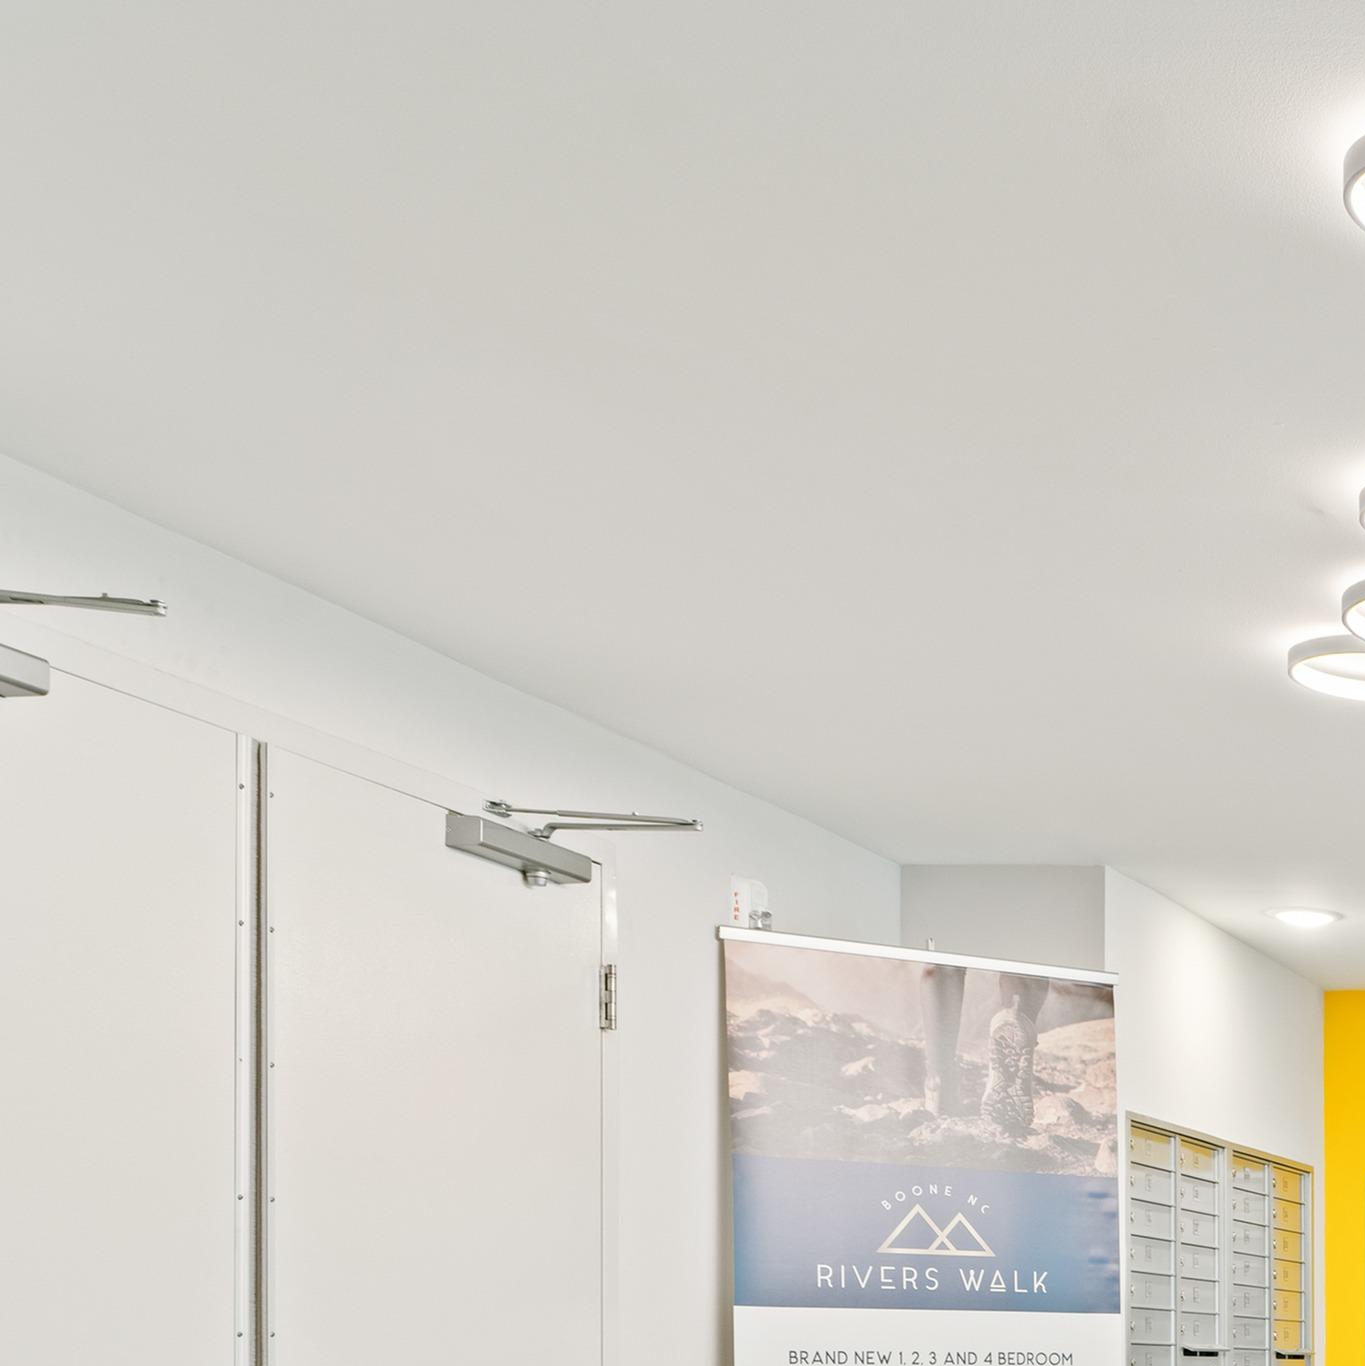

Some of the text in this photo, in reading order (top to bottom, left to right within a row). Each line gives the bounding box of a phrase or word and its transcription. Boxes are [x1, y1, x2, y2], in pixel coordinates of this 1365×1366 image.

[881, 1184, 990, 1215] BOONE NC
[816, 1264, 1048, 1294] RIVERS WALK
[788, 1350, 848, 1365] BRAND
[854, 1350, 892, 1365] NEW
[929, 1351, 937, 1365] 3
[944, 1351, 978, 1365] AND
[984, 1352, 992, 1365] 4
[998, 1352, 1073, 1366] BEDROOM
